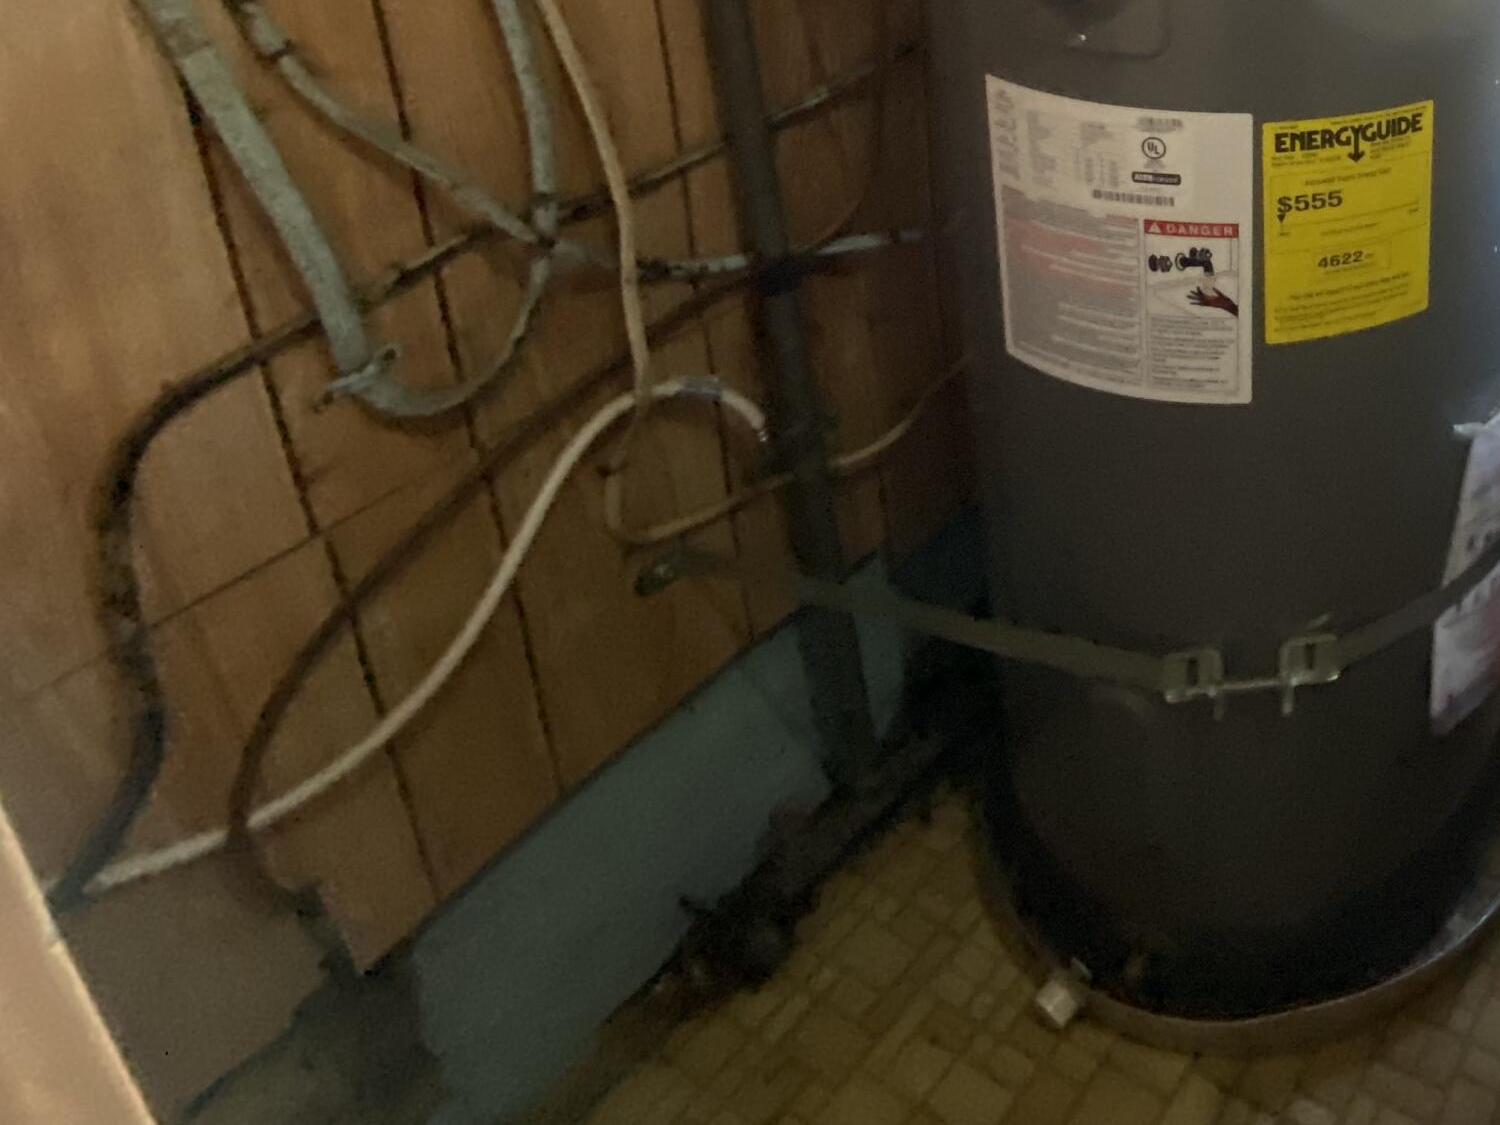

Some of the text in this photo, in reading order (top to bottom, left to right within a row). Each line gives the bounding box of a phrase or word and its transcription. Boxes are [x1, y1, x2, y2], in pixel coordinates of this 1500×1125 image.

[1274, 113, 1424, 162] ENERGYGUIDE
[1276, 190, 1343, 213] $555
[1165, 221, 1233, 236] DANGER
[1317, 250, 1364, 268] 4622
